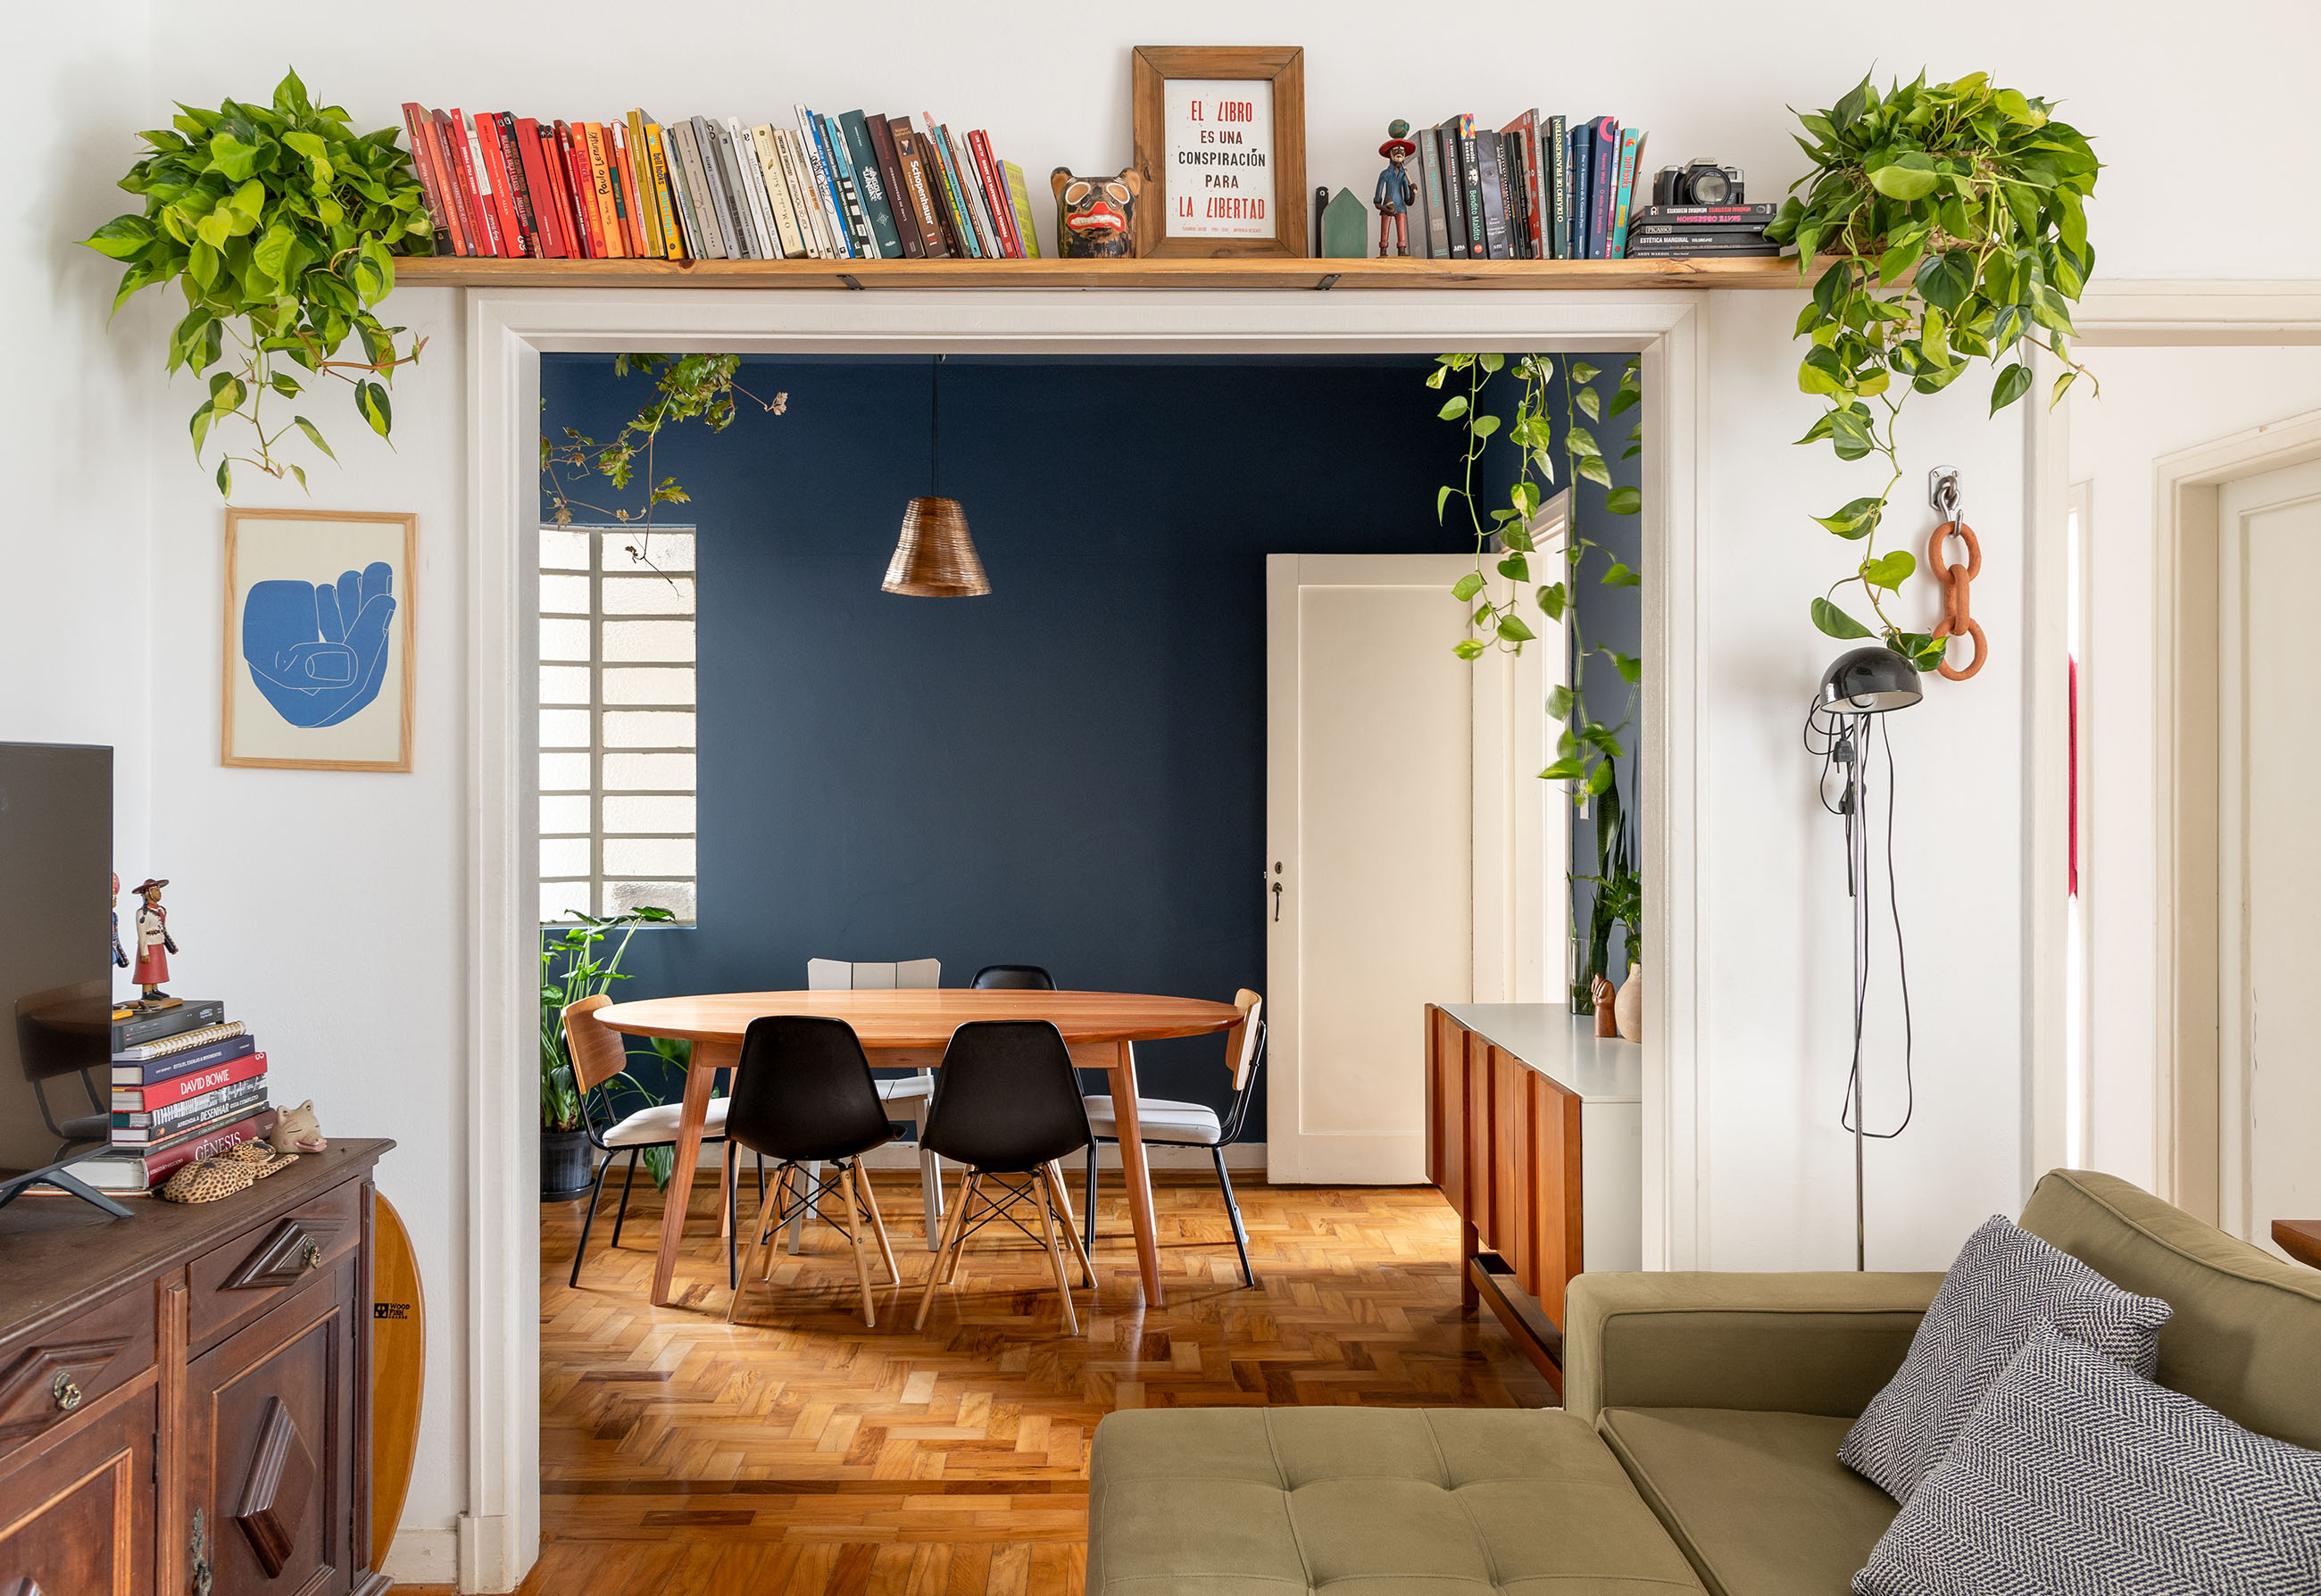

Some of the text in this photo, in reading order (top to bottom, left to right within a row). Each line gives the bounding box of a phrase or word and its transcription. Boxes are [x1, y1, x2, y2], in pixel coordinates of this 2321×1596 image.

[799, 108, 808, 126] ONESTO
[1192, 101, 1252, 122] EL LIBRO
[1201, 130, 1243, 145] ES UNA
[1554, 119, 1562, 177] FRANKENSTEIN
[977, 143, 985, 157] ALINE
[1178, 148, 1266, 167] CONSPIRACIÓN
[1463, 142, 1471, 163] Mendes
[578, 150, 591, 183] bell hooks
[587, 129, 610, 195] Paulo Leminski
[653, 153, 667, 185] bell hooks
[705, 156, 713, 171] CAPITU
[1621, 156, 1633, 188] bell hooks
[469, 177, 478, 195] COMECE
[496, 179, 504, 197] WOODY
[511, 175, 520, 192] CLASSE
[868, 166, 884, 201] ANGOLA
[1205, 174, 1239, 188] PARA
[1556, 178, 1562, 188] DE
[441, 180, 452, 204] MARGARET
[447, 205, 458, 227] ATWOOD
[452, 181, 465, 212] MARKETING
[839, 192, 848, 206] TEMPO
[909, 160, 935, 226] Schopenhauer
[982, 160, 1008, 238] PEQUENA COREOGRAFIA DO ADEUS
[516, 196, 528, 227] ANGELA DAVIS
[660, 190, 674, 237] olhares negros
[1179, 196, 1265, 220] LA LIBERTAD
[1468, 189, 1482, 241] Bendito Maldito
[1558, 215, 1564, 223] O
[742, 211, 756, 254] GRACILIANO RAMOS
[180, 1079, 204, 1094] DAVID
[206, 1072, 229, 1088] BOWIE
[240, 1095, 259, 1106] COMPLETO
[200, 1104, 229, 1121] DESENHAR
[195, 1131, 242, 1161] GÊNESIS
